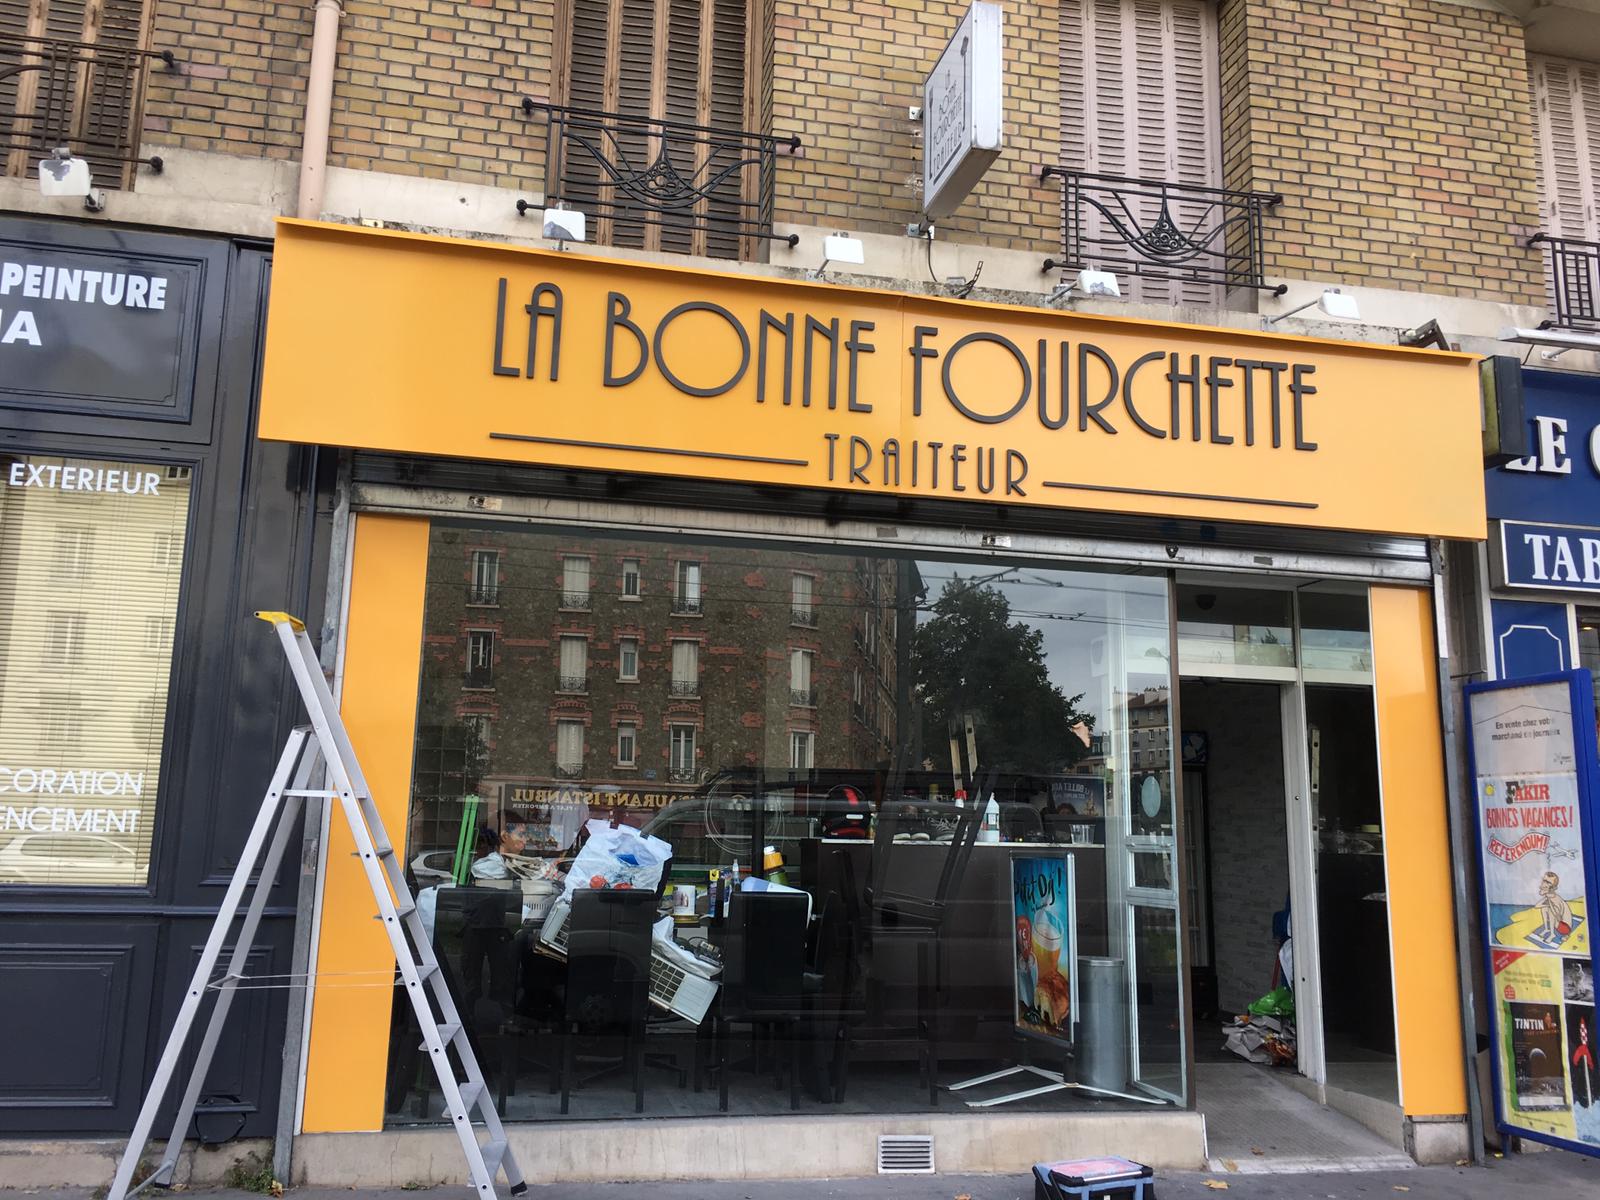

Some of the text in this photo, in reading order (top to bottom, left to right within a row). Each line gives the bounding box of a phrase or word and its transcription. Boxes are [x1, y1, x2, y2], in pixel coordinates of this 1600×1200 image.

[933, 121, 962, 177] TRAITEUR
[0, 262, 168, 310] PEINTURE
[0, 309, 42, 346] A
[492, 277, 1318, 451] LA BONNE FOURCHETTE
[9, 462, 160, 496] EXTERIEUR
[823, 433, 1029, 497] TRAITEUR
[1523, 534, 1600, 584] TAB
[1523, 719, 1537, 727] chez
[1505, 781, 1550, 804] FAKIR
[1486, 807, 1519, 828] BONNES
[1514, 1017, 1545, 1030] TINTIN
